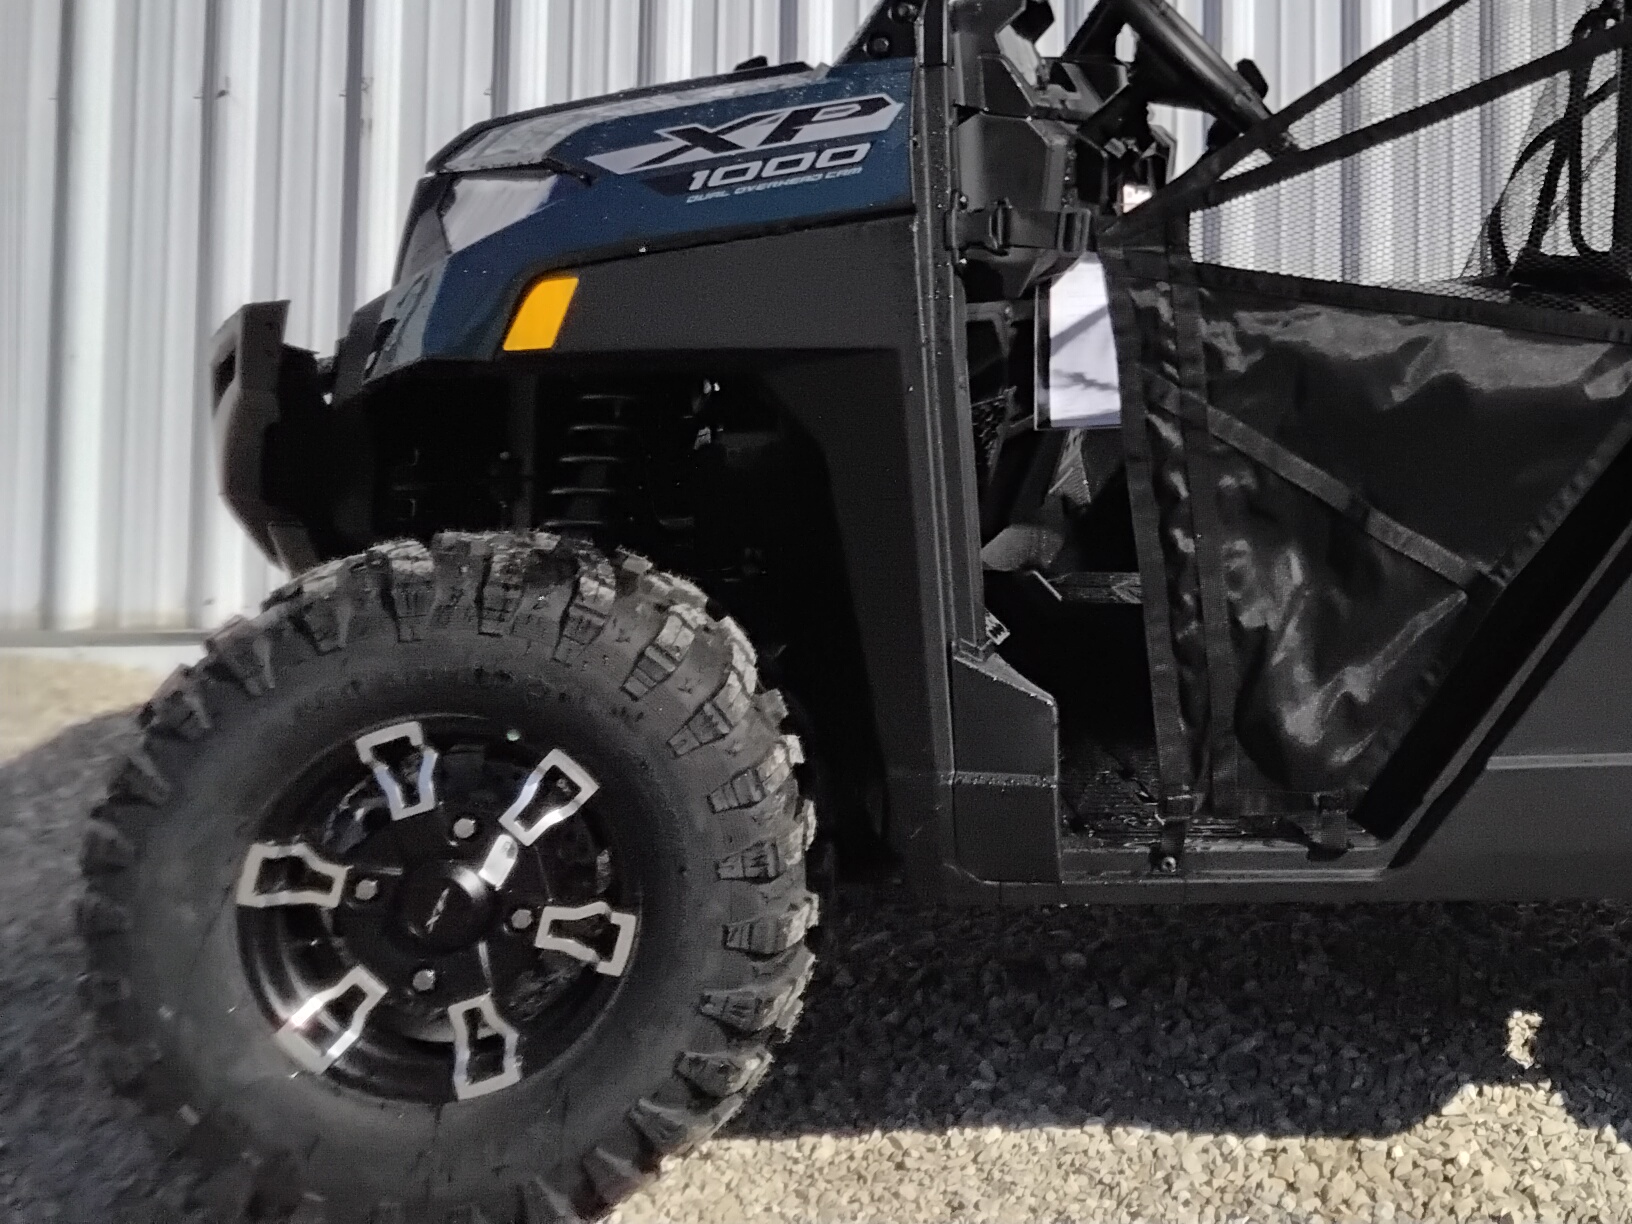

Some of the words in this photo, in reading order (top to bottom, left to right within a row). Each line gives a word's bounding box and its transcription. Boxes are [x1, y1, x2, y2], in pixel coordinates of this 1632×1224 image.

[628, 95, 893, 171] XP
[686, 190, 730, 204] DUAL
[734, 173, 824, 195] OVERHEAD
[824, 166, 863, 180] CAM
[688, 142, 871, 191] 1000
